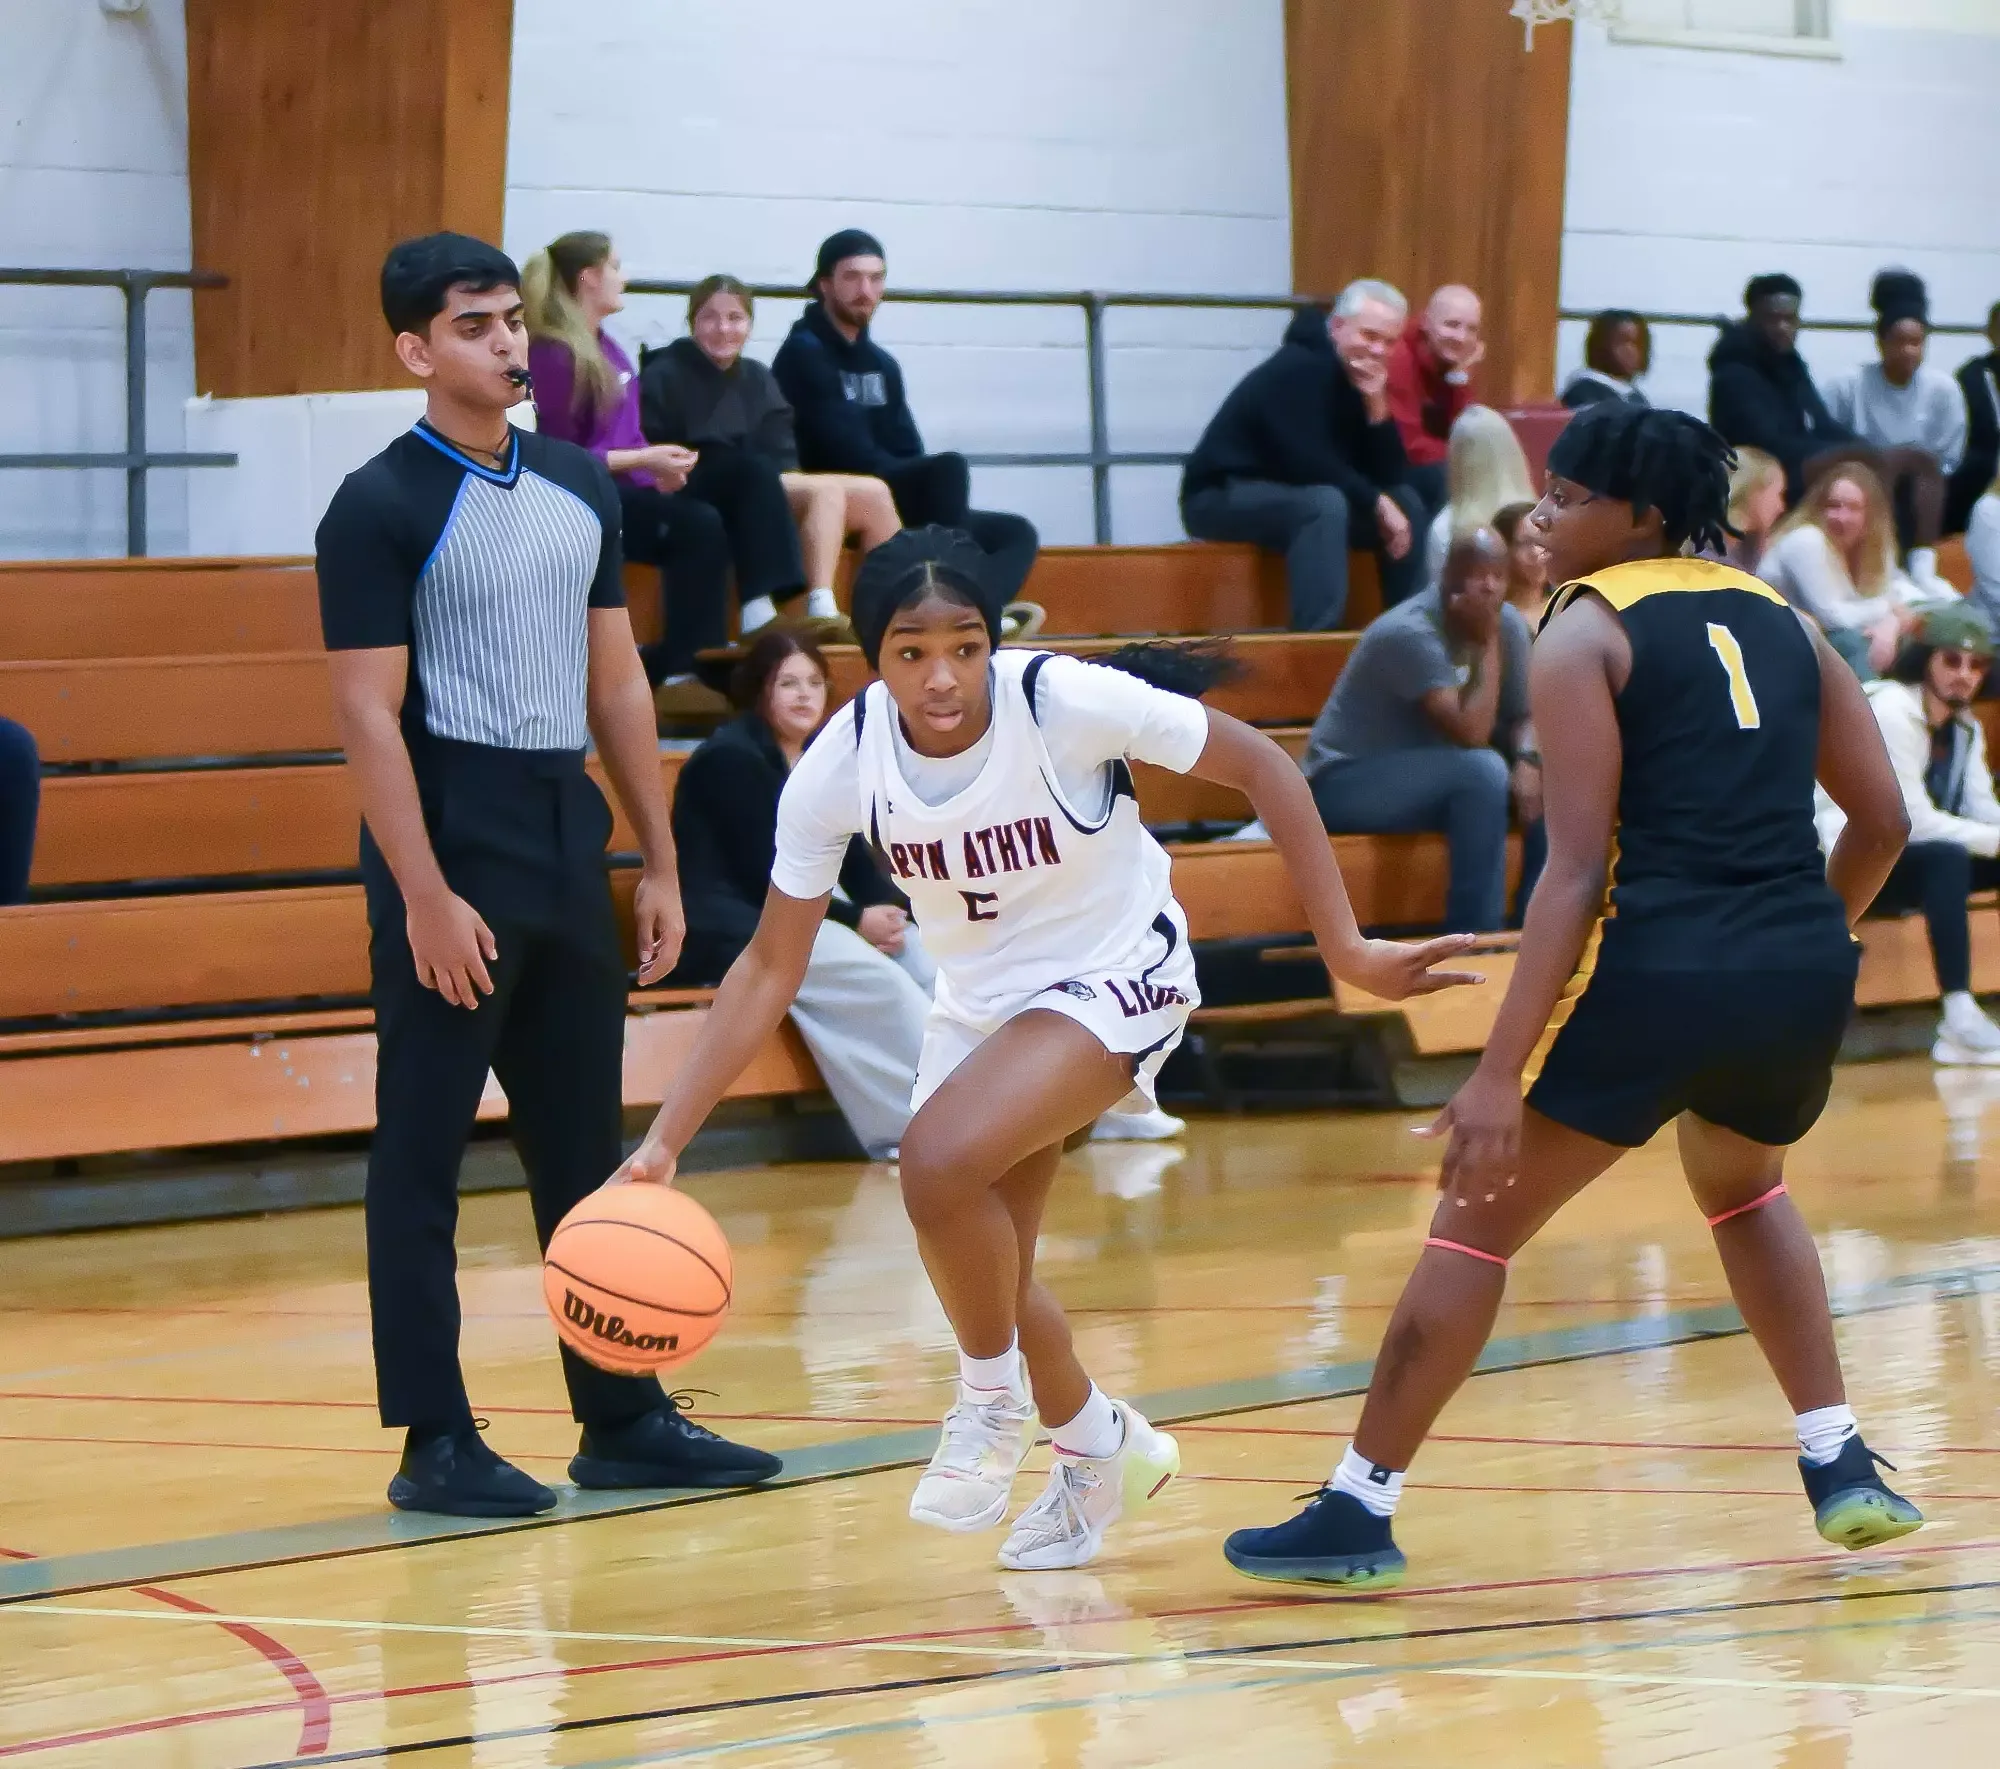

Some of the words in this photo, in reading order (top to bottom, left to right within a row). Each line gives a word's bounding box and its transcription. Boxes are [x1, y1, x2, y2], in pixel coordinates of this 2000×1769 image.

[1706, 622, 1760, 729] 1
[890, 839, 951, 881] RYN
[963, 816, 1062, 879] ATHYN
[564, 1287, 679, 1352] Wilson
